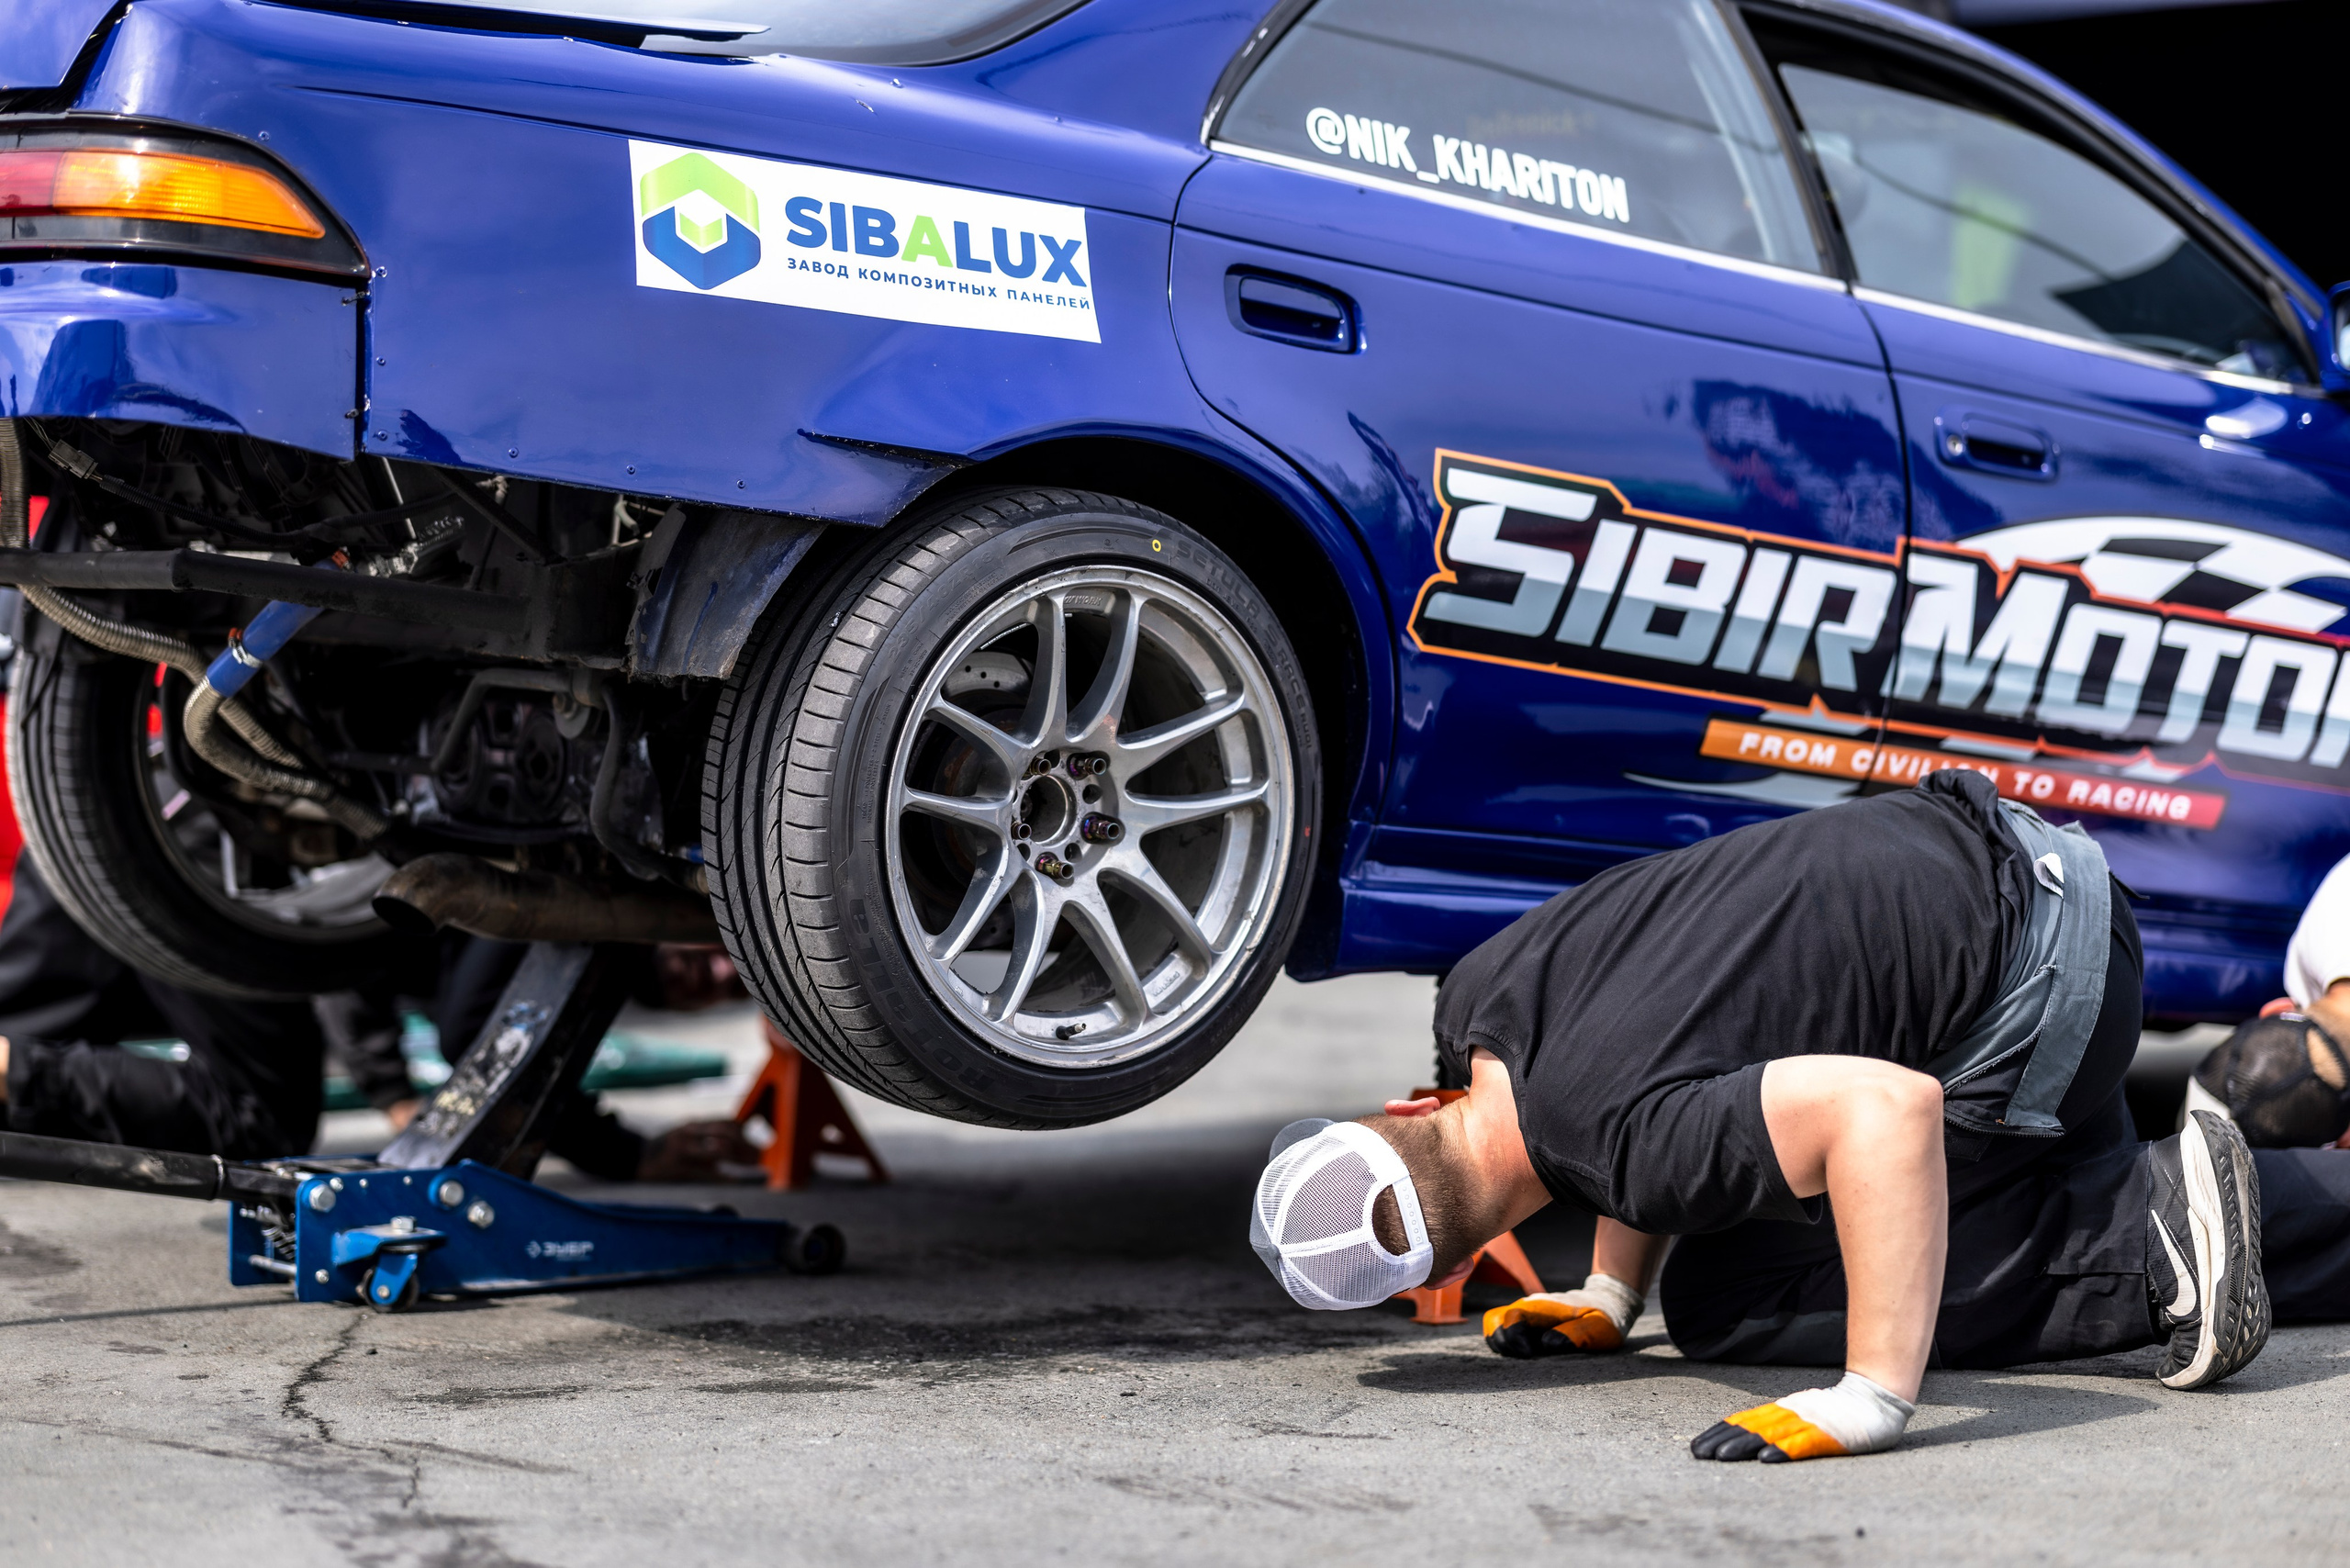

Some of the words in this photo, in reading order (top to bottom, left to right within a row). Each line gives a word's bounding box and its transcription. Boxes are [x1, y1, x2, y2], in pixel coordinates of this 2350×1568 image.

[1305, 107, 1629, 223] @NIK_KHARITON
[785, 196, 1087, 287] SIBALUX
[788, 257, 849, 279] ЗАВОД
[858, 267, 997, 297] КОМПОЗИТНЫХ
[1007, 289, 1091, 310] ПАНЕЛЕЙ
[1424, 467, 1897, 692] SIBIR
[1738, 732, 1837, 767] FROM
[2014, 770, 2055, 800] TO
[2067, 779, 2193, 821] RACING
